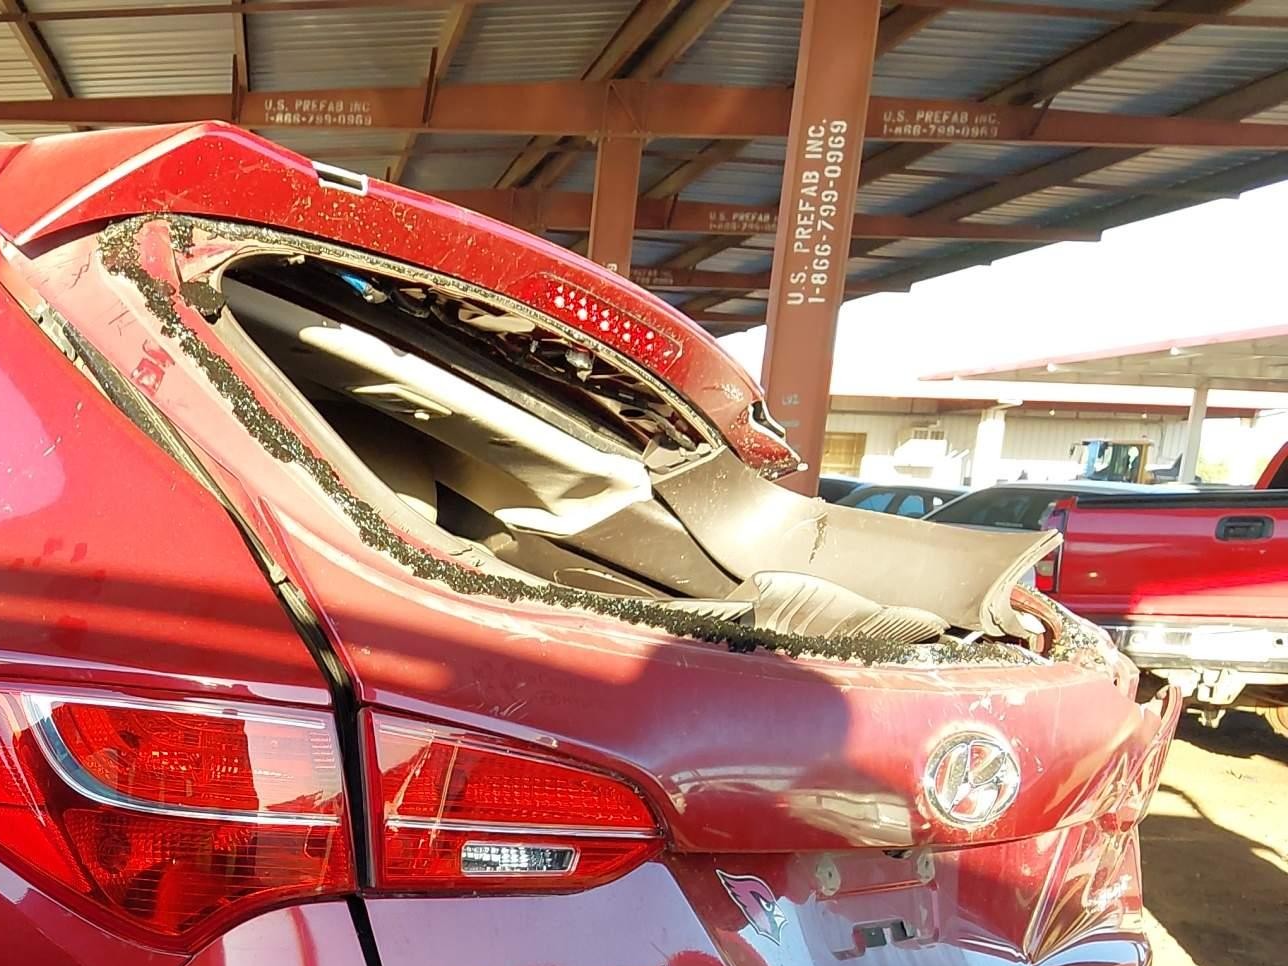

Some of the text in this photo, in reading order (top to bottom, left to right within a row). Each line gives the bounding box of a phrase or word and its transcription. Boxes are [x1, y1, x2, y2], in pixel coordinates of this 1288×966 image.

[295, 100, 344, 112] PREFAB
[916, 111, 969, 124] PREFAB
[787, 118, 827, 305] U.S. PREFAB INC.
[808, 120, 847, 304] 1-866-799-0969
